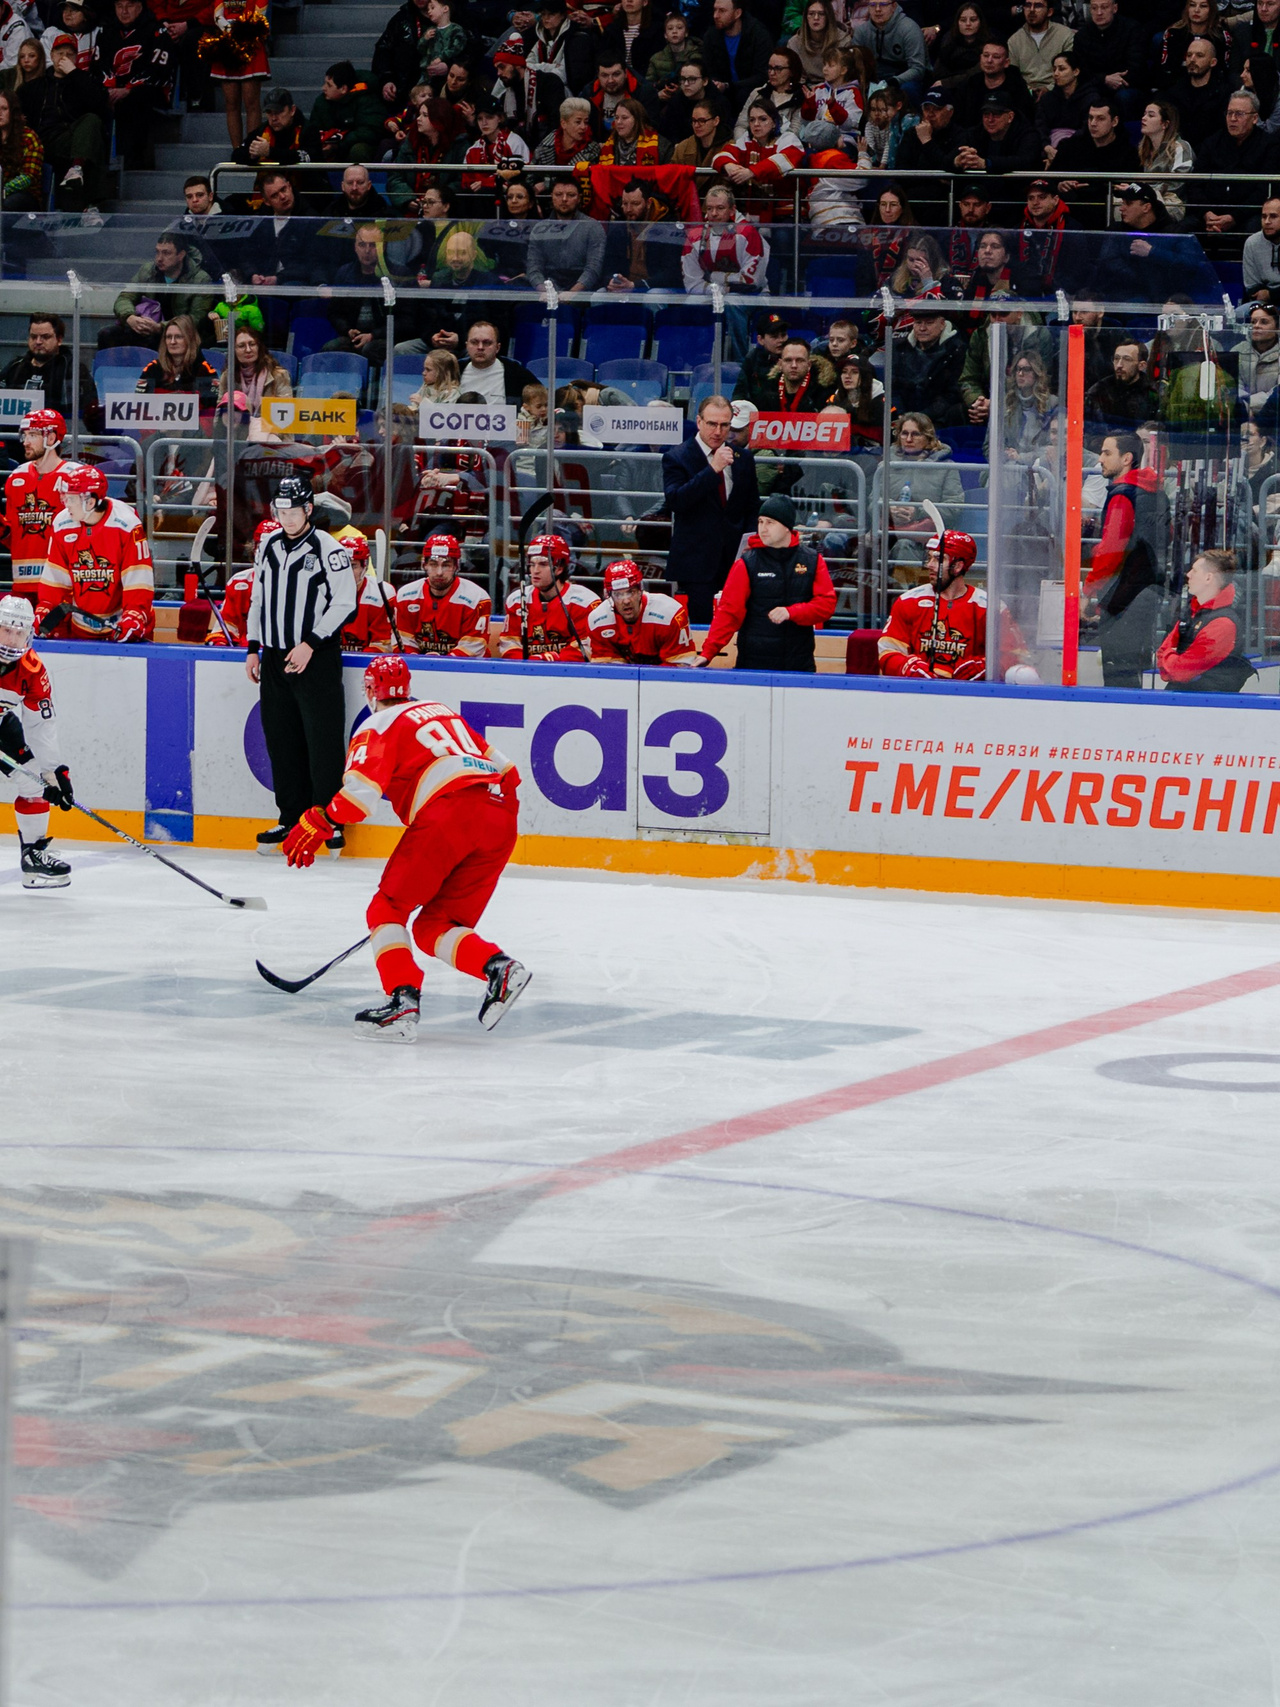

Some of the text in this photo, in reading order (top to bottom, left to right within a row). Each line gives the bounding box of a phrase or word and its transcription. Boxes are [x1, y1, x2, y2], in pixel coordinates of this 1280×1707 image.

[110, 401, 195, 422] KHL.RU
[298, 410, 346, 423] БАНК
[611, 418, 679, 432] ГАЗПРОМБАНК
[751, 419, 849, 443] FONBET
[134, 541, 149, 561] 10
[328, 551, 350, 571] 96
[71, 569, 115, 583] REDSTAR
[38, 698, 55, 720] 8
[415, 718, 483, 758] 84
[243, 698, 731, 819] газ
[847, 736, 1280, 769] МЫ ВСЕГДА НА СВЯЗИ #REDSTARHOCKEY #UNITE
